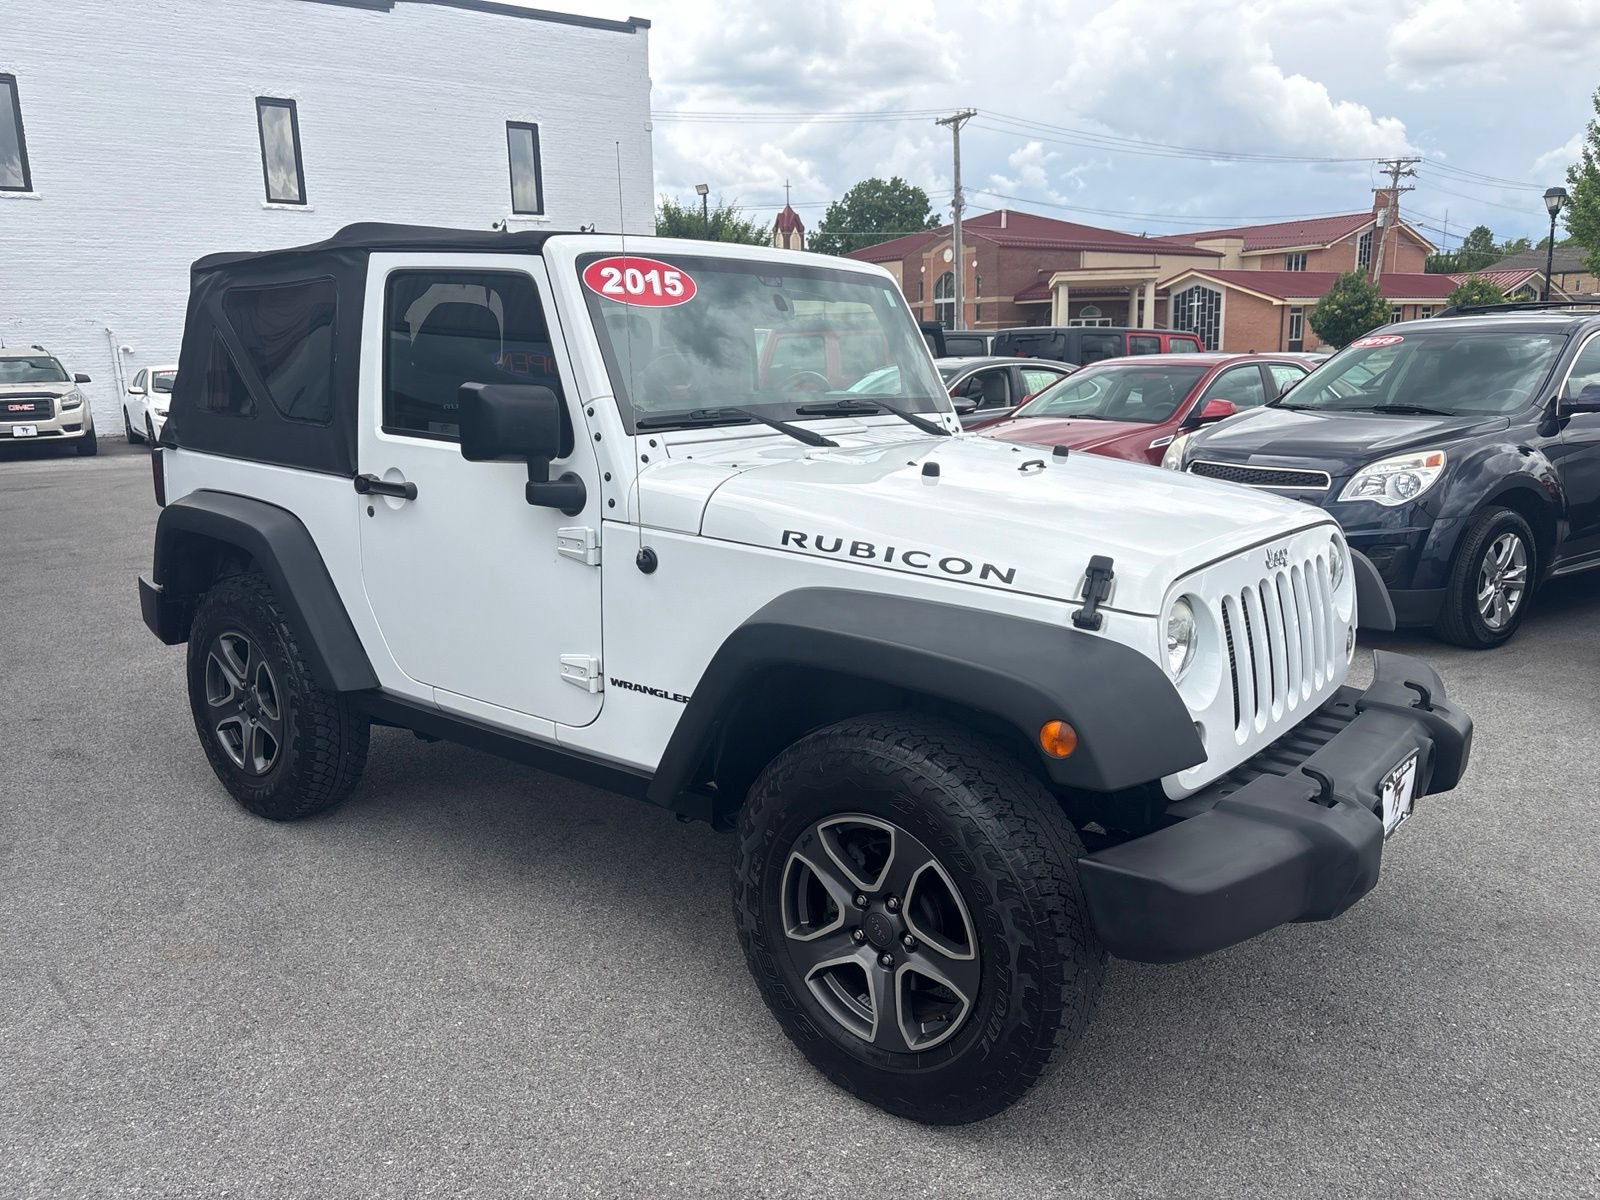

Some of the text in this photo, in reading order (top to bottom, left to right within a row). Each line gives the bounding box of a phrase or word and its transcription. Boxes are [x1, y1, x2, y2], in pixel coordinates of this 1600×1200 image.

[600, 267, 685, 297] 2015
[8, 403, 35, 411] GMC
[781, 530, 1017, 584] RUBICON
